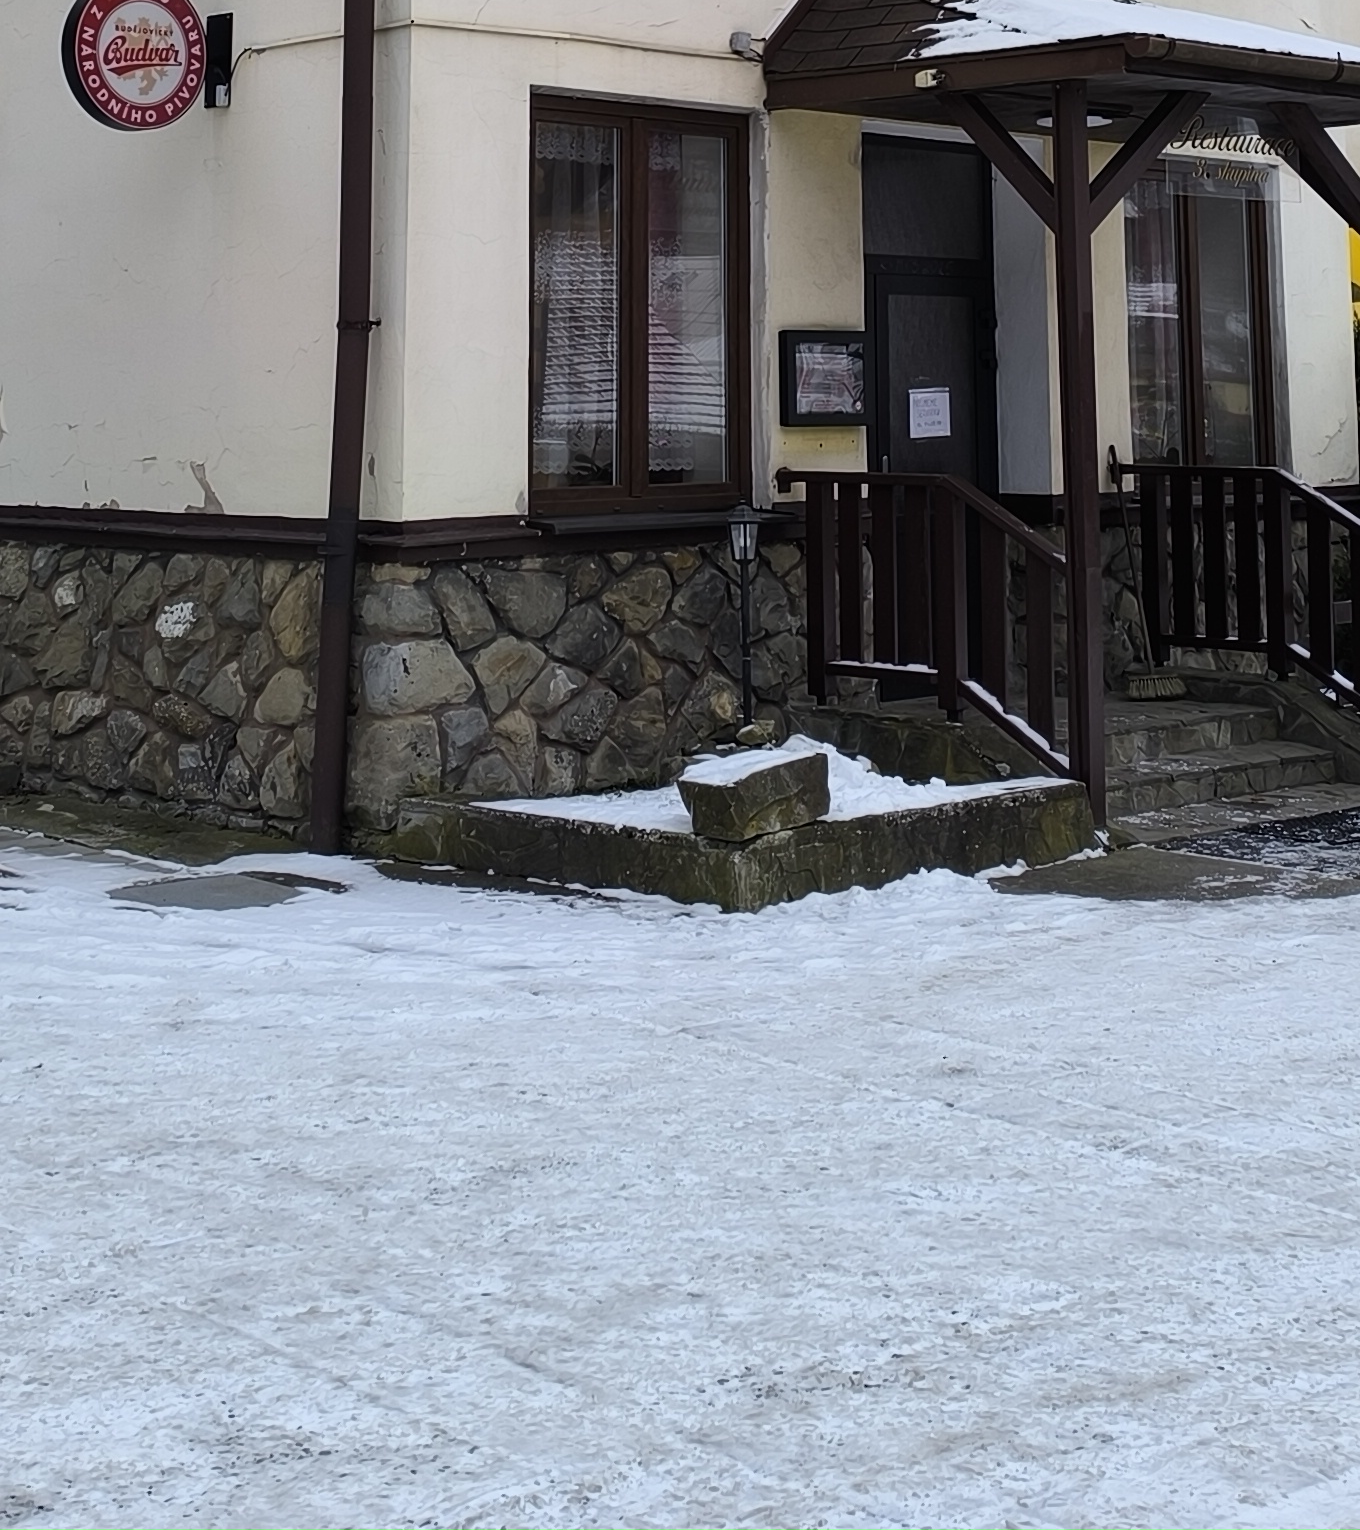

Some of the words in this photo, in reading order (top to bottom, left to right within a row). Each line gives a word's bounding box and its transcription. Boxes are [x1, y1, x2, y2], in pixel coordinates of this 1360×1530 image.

[90, 5, 103, 20] Z
[103, 35, 182, 70] Budvar
[165, 15, 202, 116] PIVOVARU
[81, 26, 157, 123] NÁRODNÍHO
[1170, 114, 1297, 157] Restaurace
[1215, 160, 1270, 187] skupina
